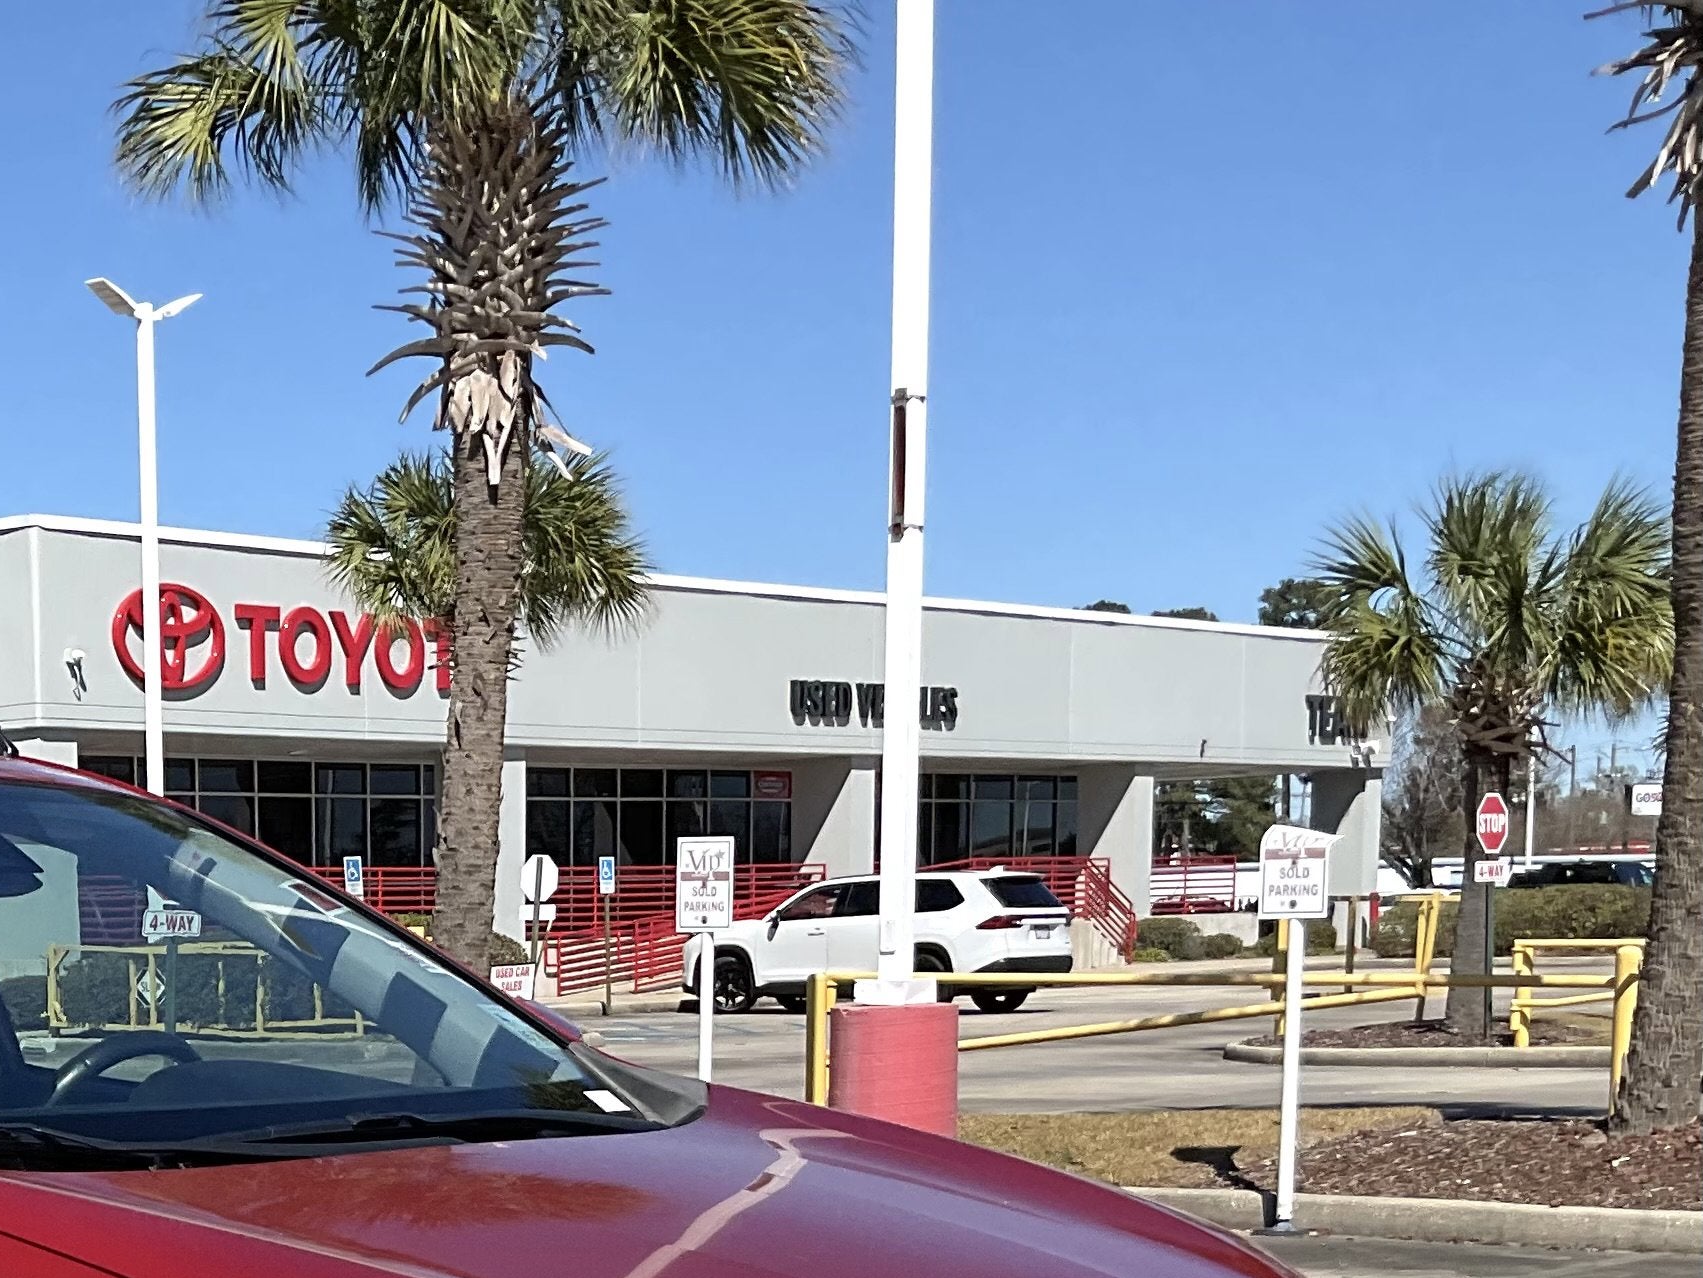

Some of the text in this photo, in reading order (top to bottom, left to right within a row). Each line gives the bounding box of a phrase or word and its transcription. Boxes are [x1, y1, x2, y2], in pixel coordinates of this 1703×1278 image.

[234, 603, 458, 690] TOYOT
[790, 680, 958, 726] USED VELES
[1479, 813, 1505, 833] STOP
[1280, 867, 1310, 879] SOLD
[1479, 865, 1503, 877] 4-WAY
[692, 886, 717, 897] SOLD
[1268, 884, 1318, 897] PARKING
[684, 901, 725, 912] PARKING
[150, 914, 194, 932] 4-WAY
[496, 967, 529, 978] USED CAR
[502, 981, 522, 991] SALES
